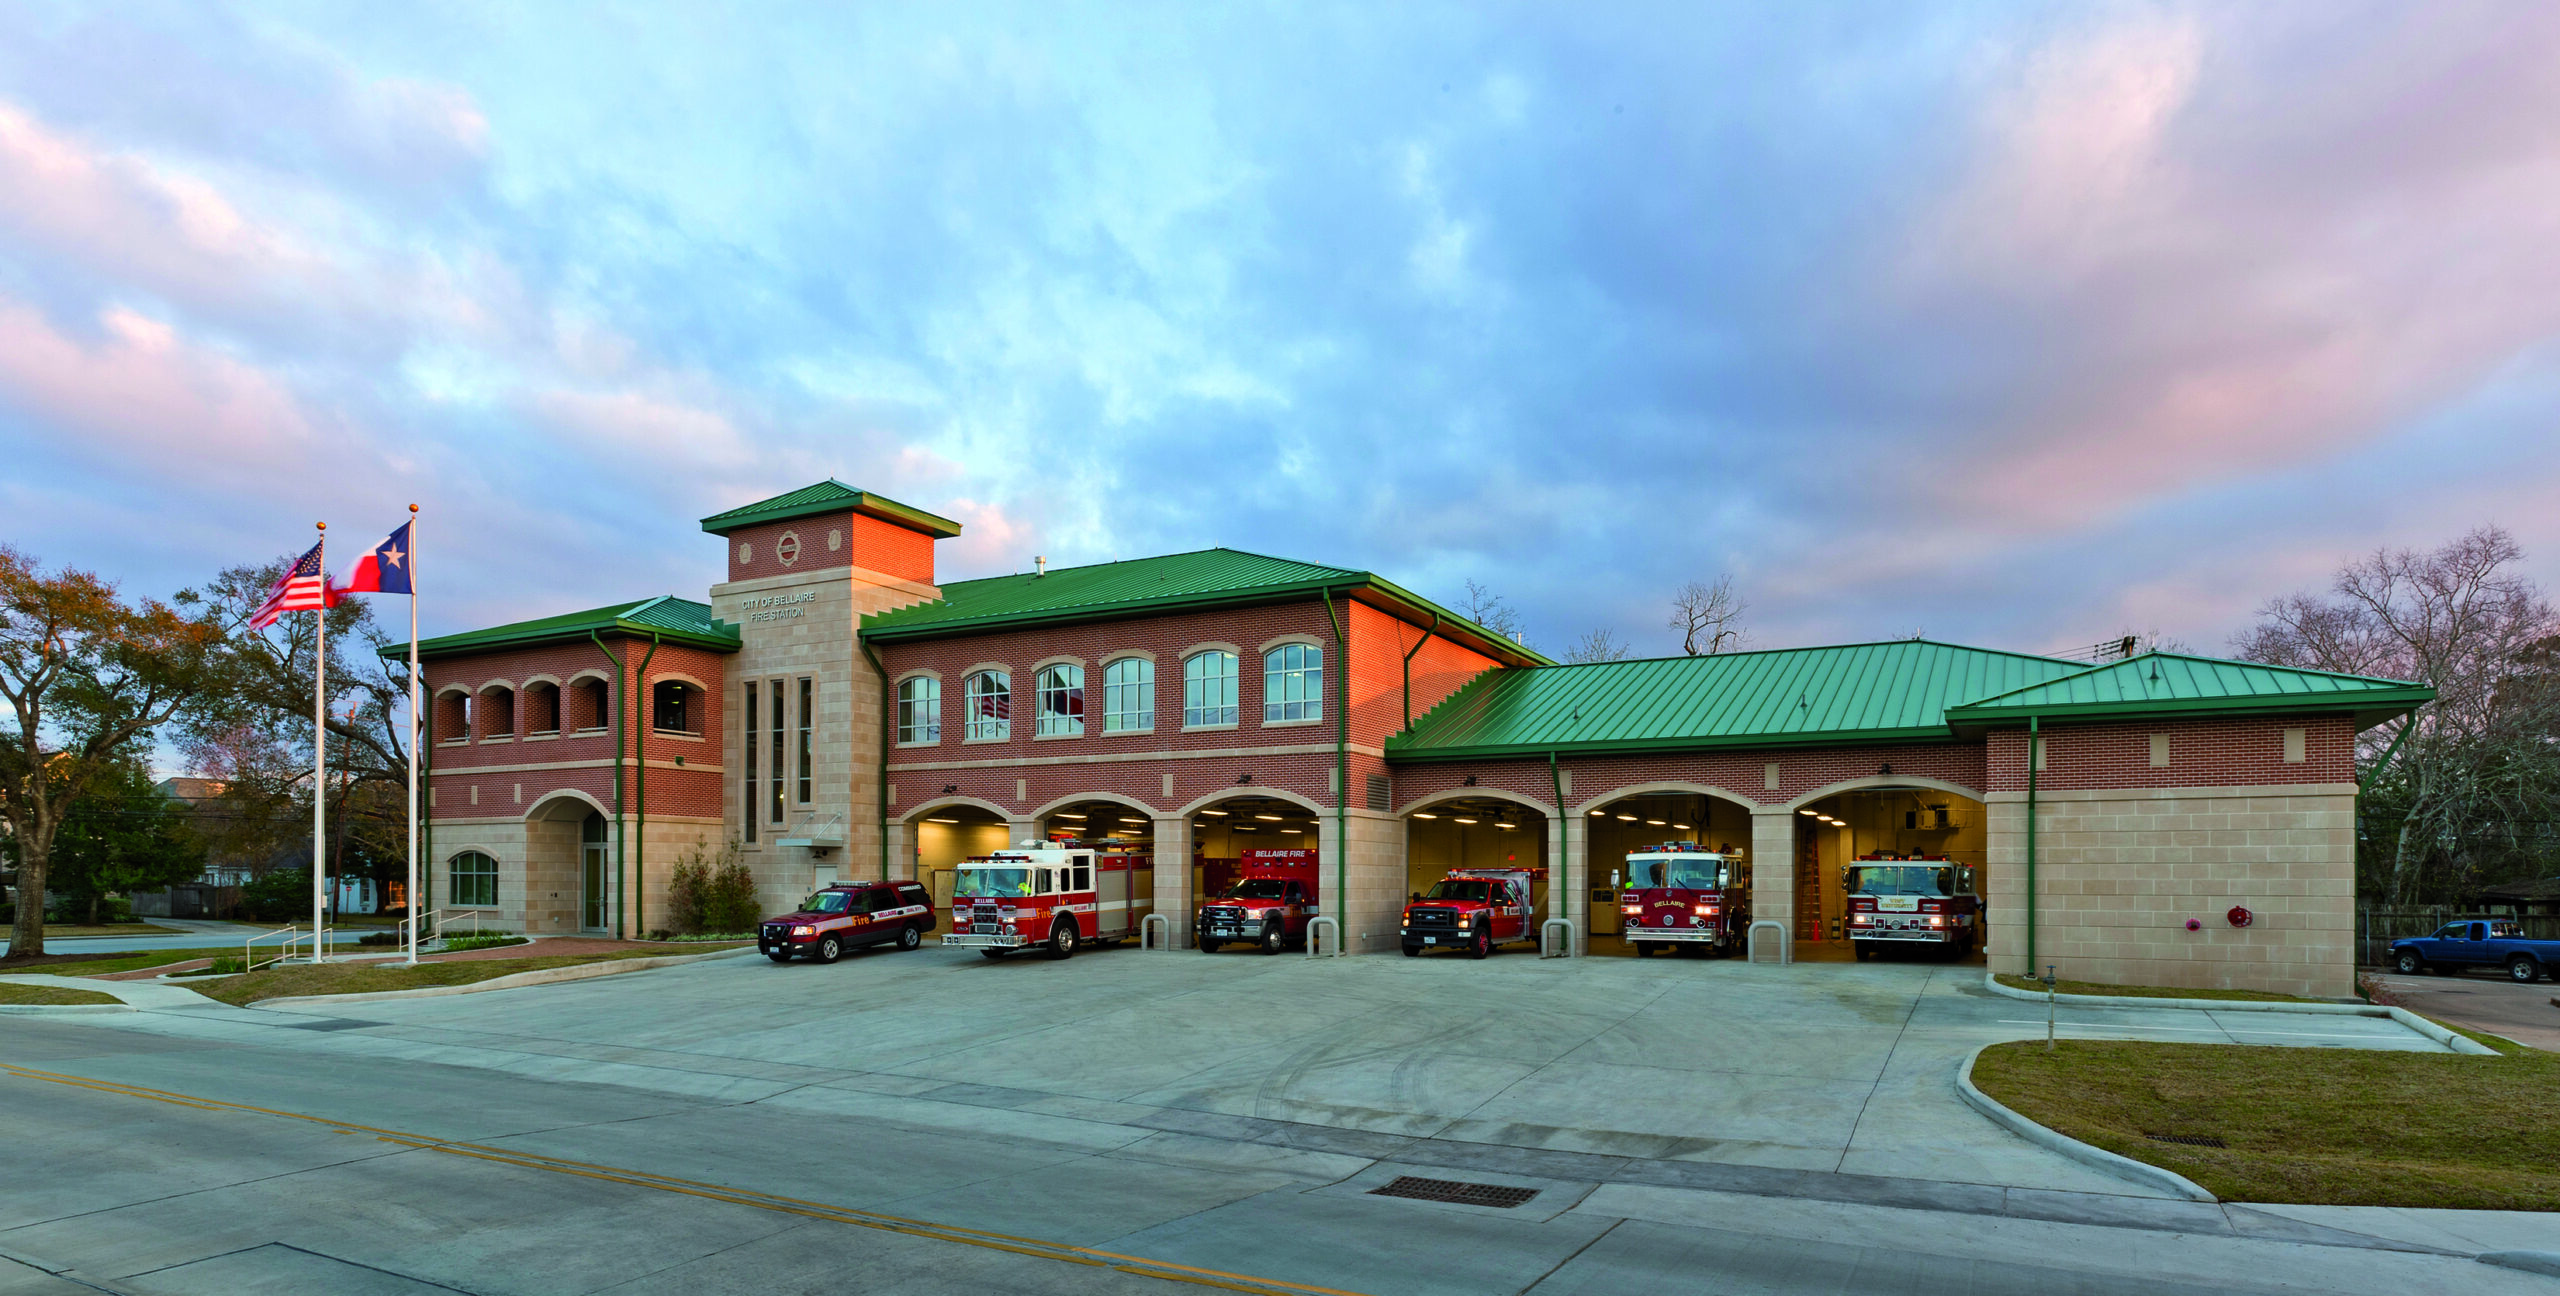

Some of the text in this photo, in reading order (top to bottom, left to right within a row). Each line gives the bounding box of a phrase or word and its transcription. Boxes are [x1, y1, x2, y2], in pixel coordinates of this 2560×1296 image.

[742, 592, 815, 610] CITY OF BELLAIRE
[751, 608, 804, 622] FIRE STATION
[1255, 850, 1306, 858] BELLAIRE FIRE
[1654, 900, 1686, 908] BELLAIRE
[878, 910, 897, 918] BELLAIRE
[1036, 907, 1051, 919] Fire
[852, 915, 870, 926] Fire
